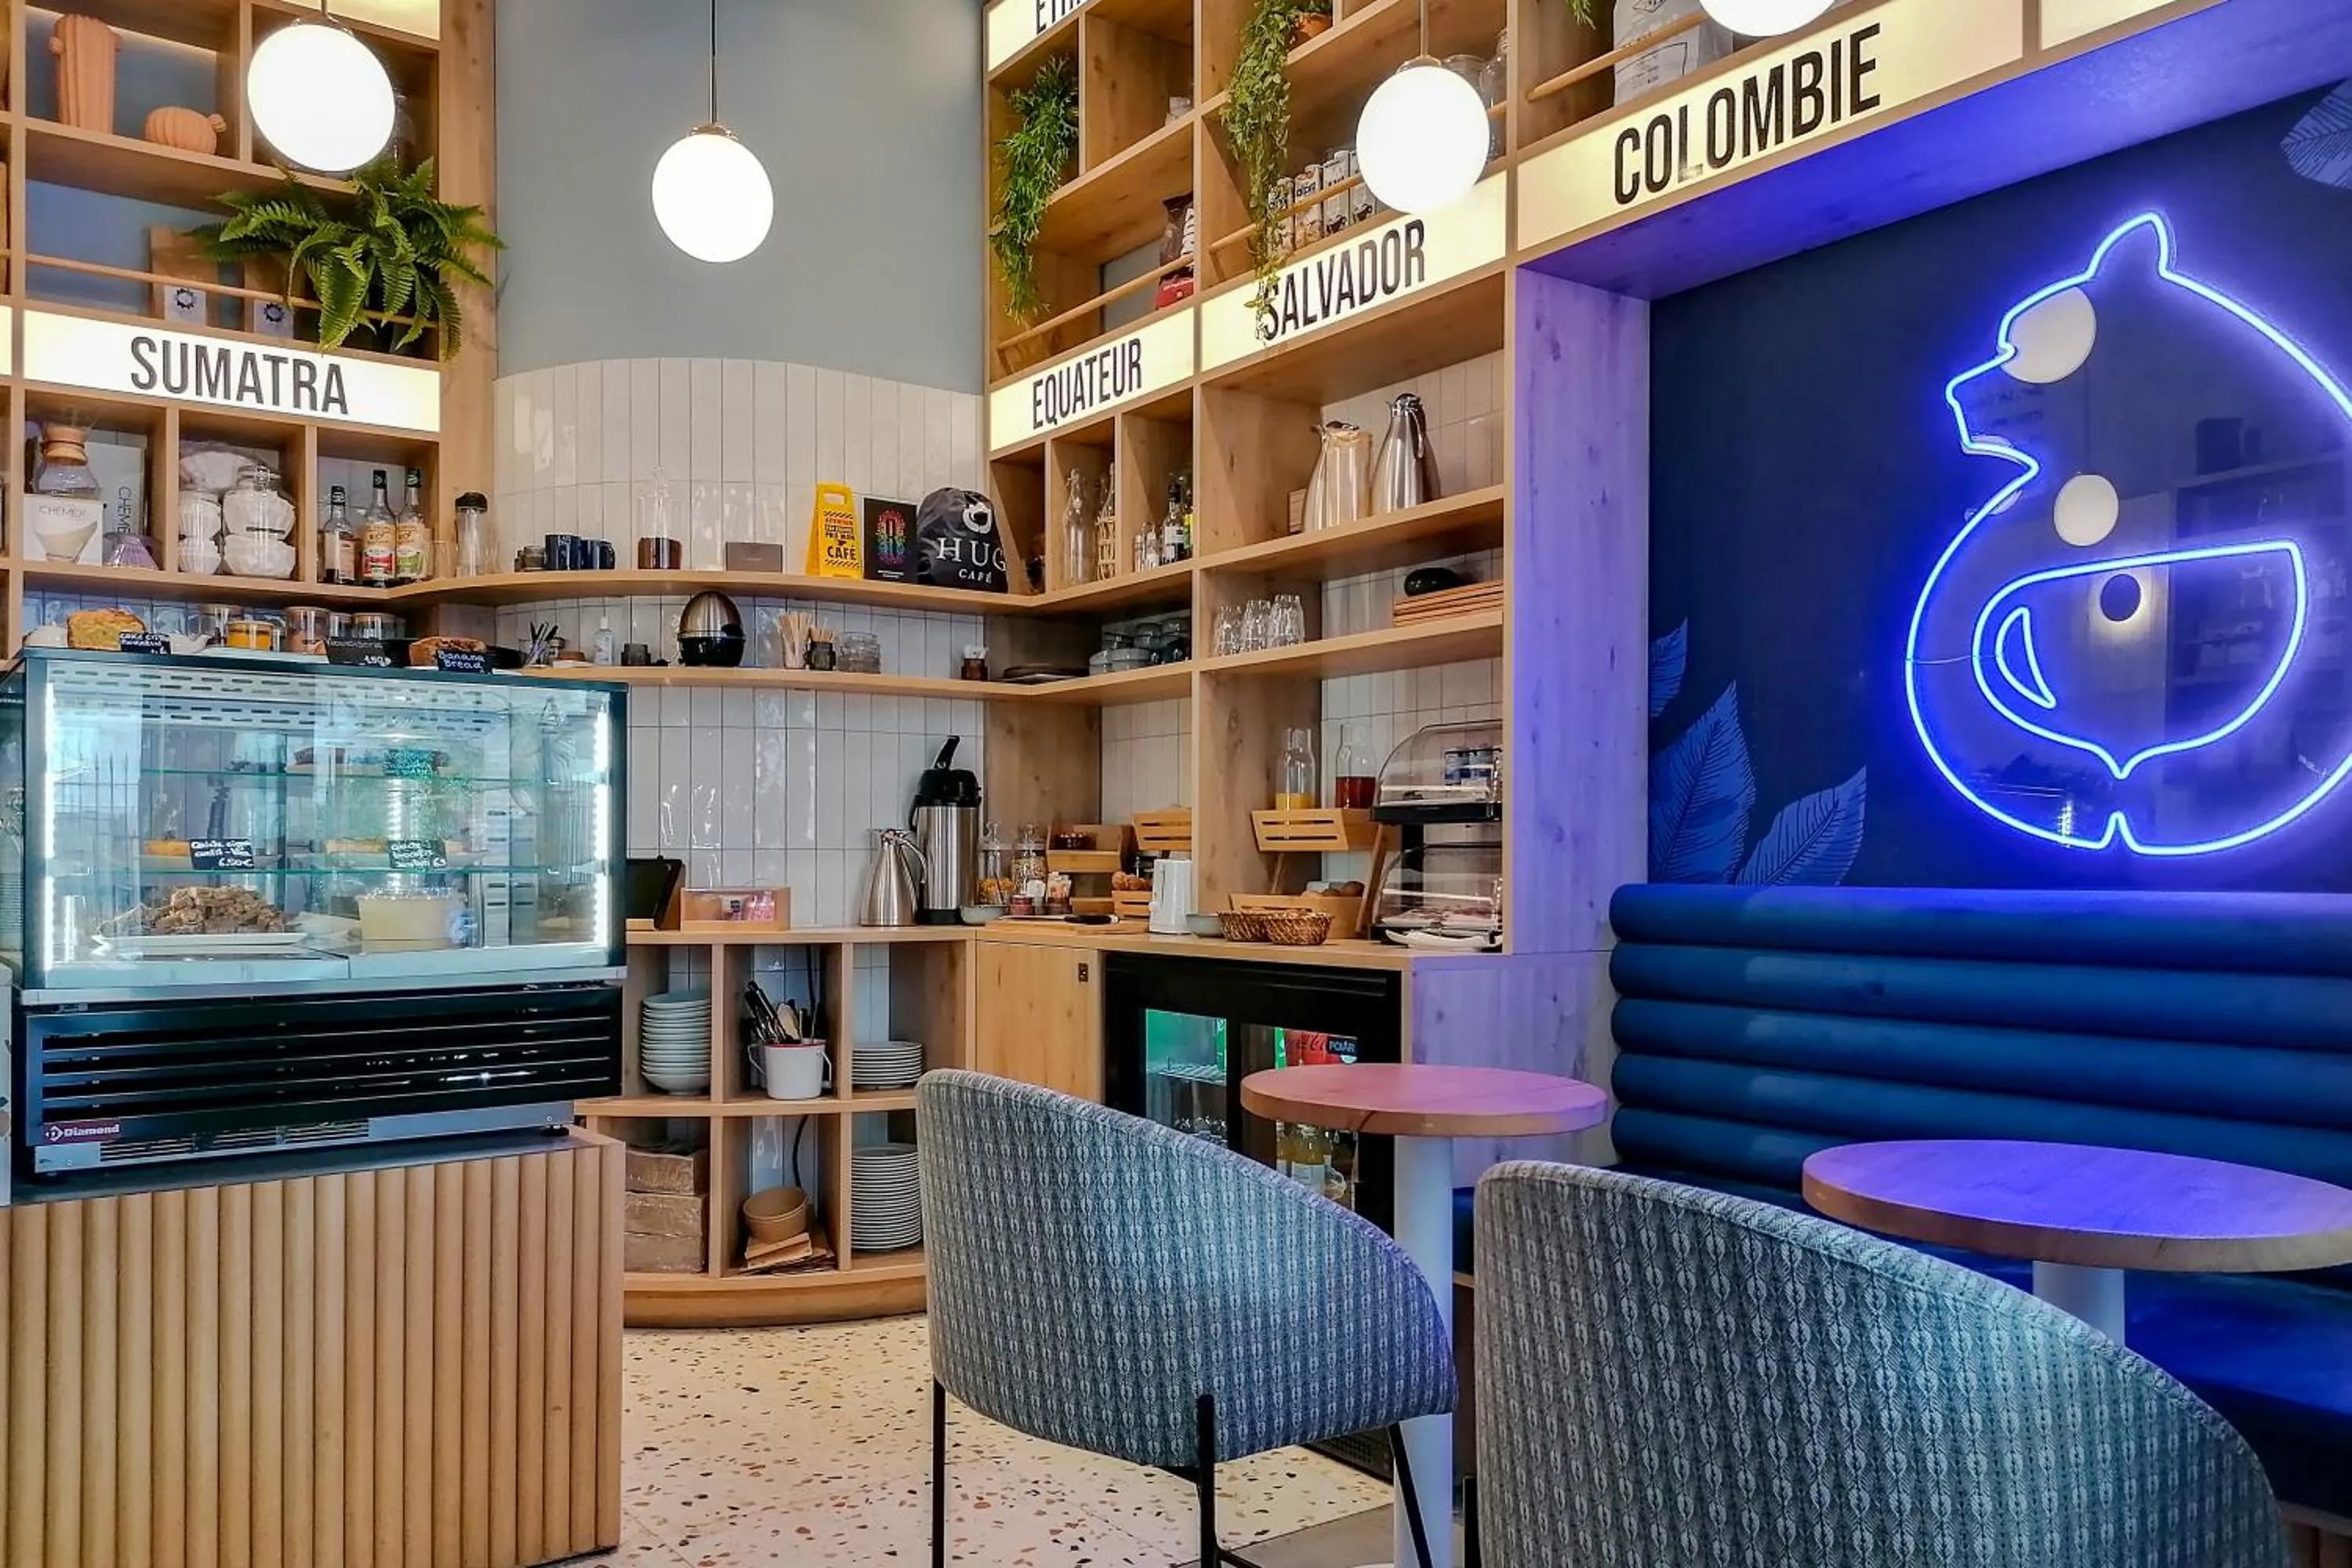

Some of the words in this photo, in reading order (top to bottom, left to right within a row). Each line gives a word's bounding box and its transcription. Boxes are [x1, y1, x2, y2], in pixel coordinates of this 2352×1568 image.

[1614, 23, 1881, 205] COLOMBIE
[1261, 219, 1425, 341] SALVADOR
[130, 336, 349, 415] SUMATRA
[1033, 338, 1142, 430] EQUATEUR
[118, 486, 132, 536] CHEME
[827, 545, 857, 561] CAFÉ
[936, 537, 1007, 572] HUG
[959, 568, 992, 583] CAFÉ
[437, 650, 485, 663] Banana
[64, 1123, 120, 1138] Diamond
